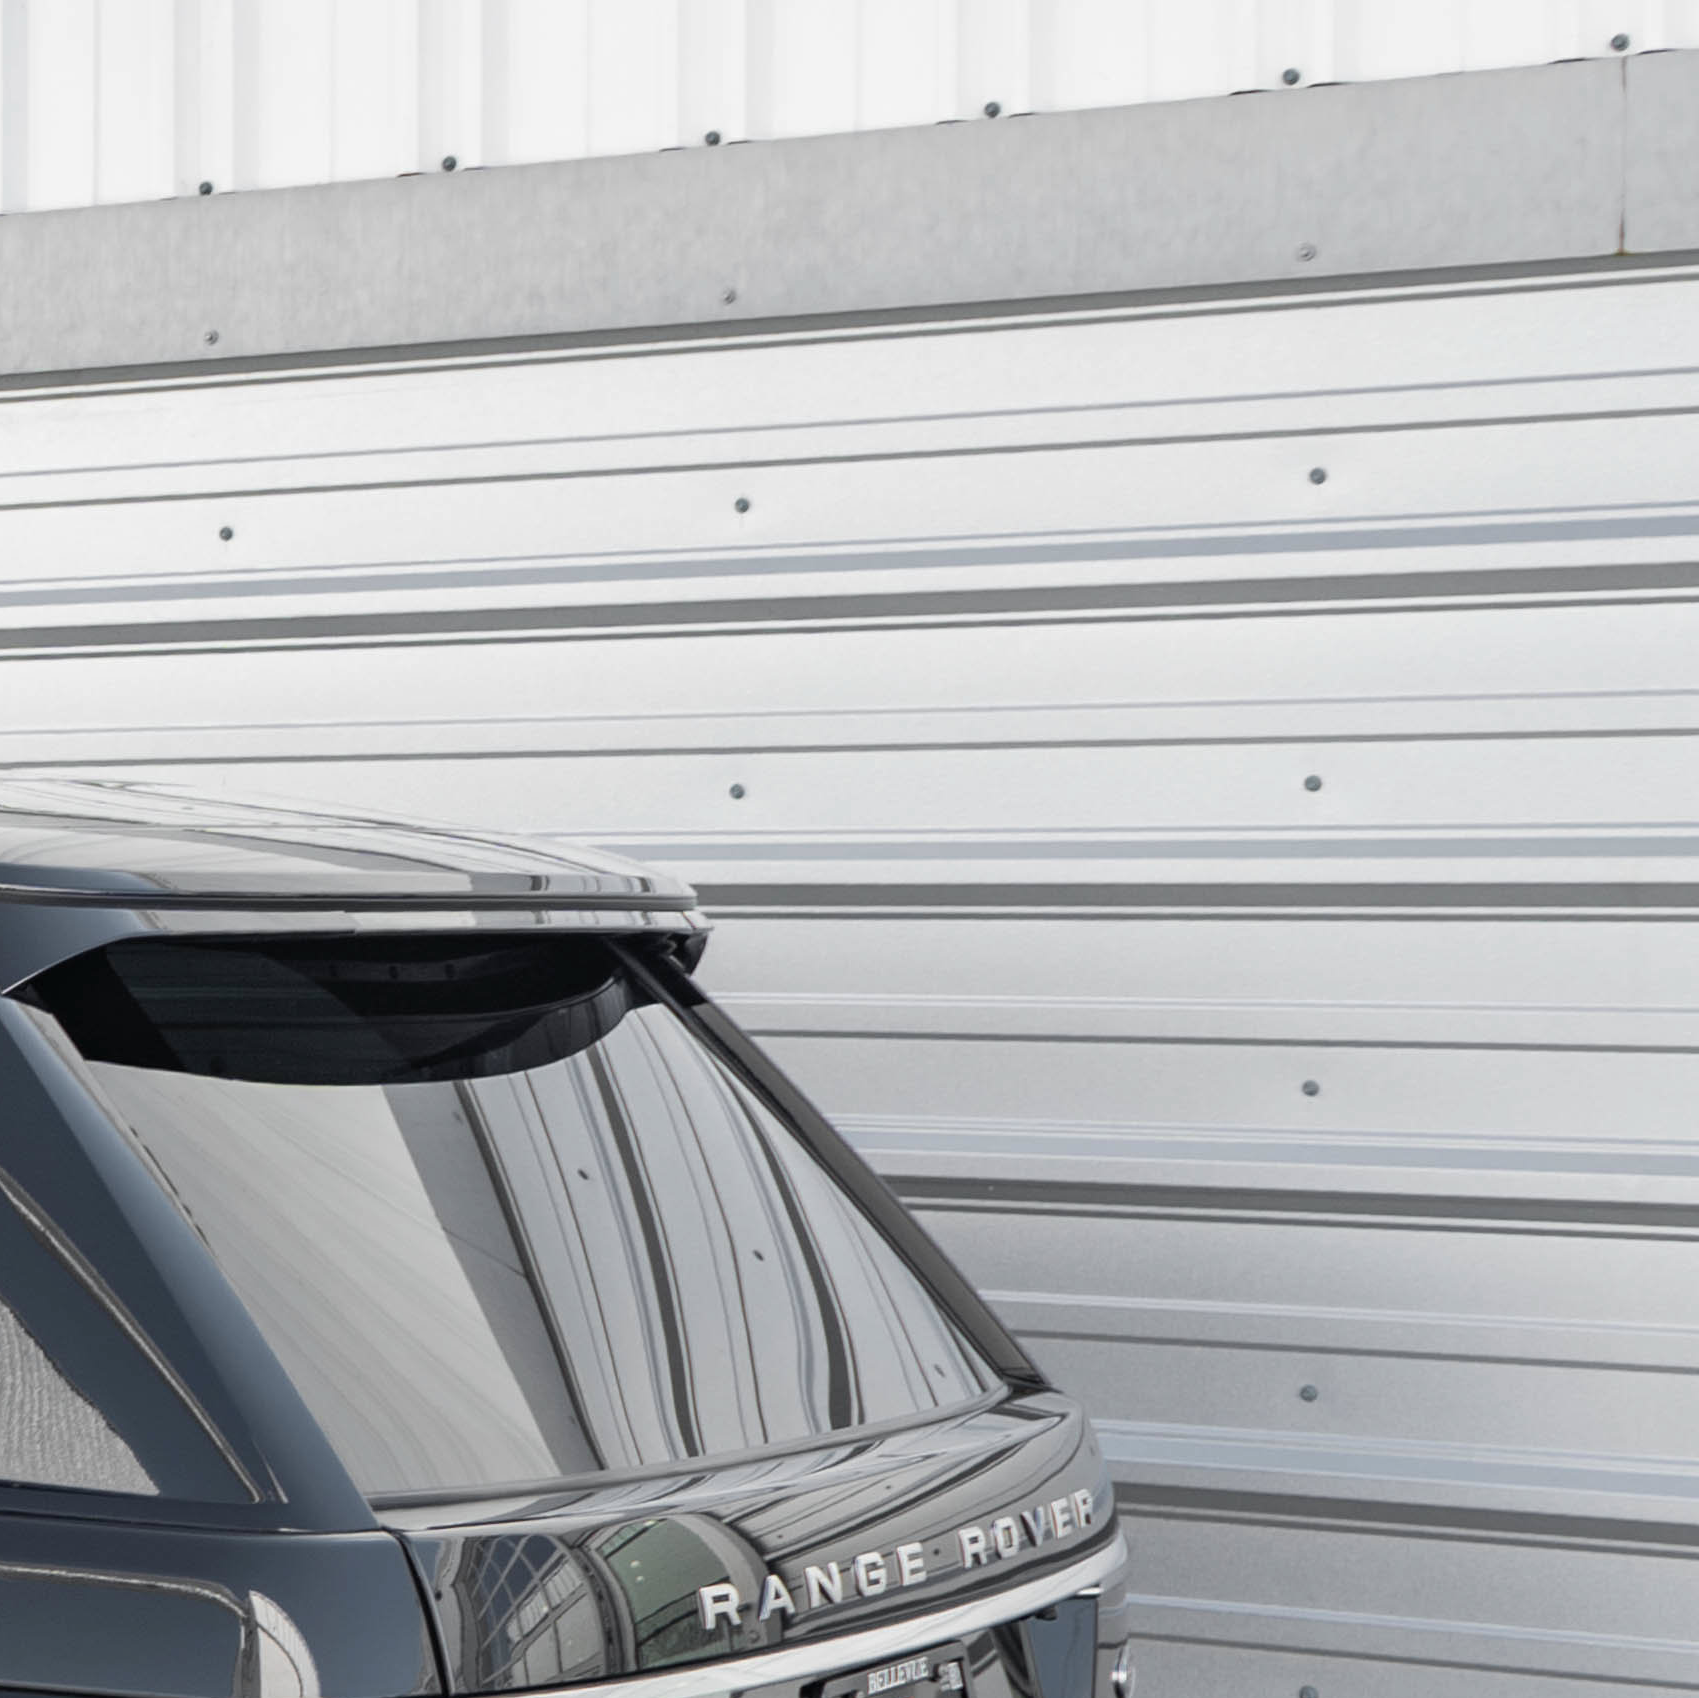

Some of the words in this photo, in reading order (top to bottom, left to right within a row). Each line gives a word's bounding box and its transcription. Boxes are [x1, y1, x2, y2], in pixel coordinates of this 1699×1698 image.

[699, 1541, 929, 1631] RANGE
[956, 1487, 1094, 1570] ROVER
[867, 1655, 930, 1696] BELLEVUE
